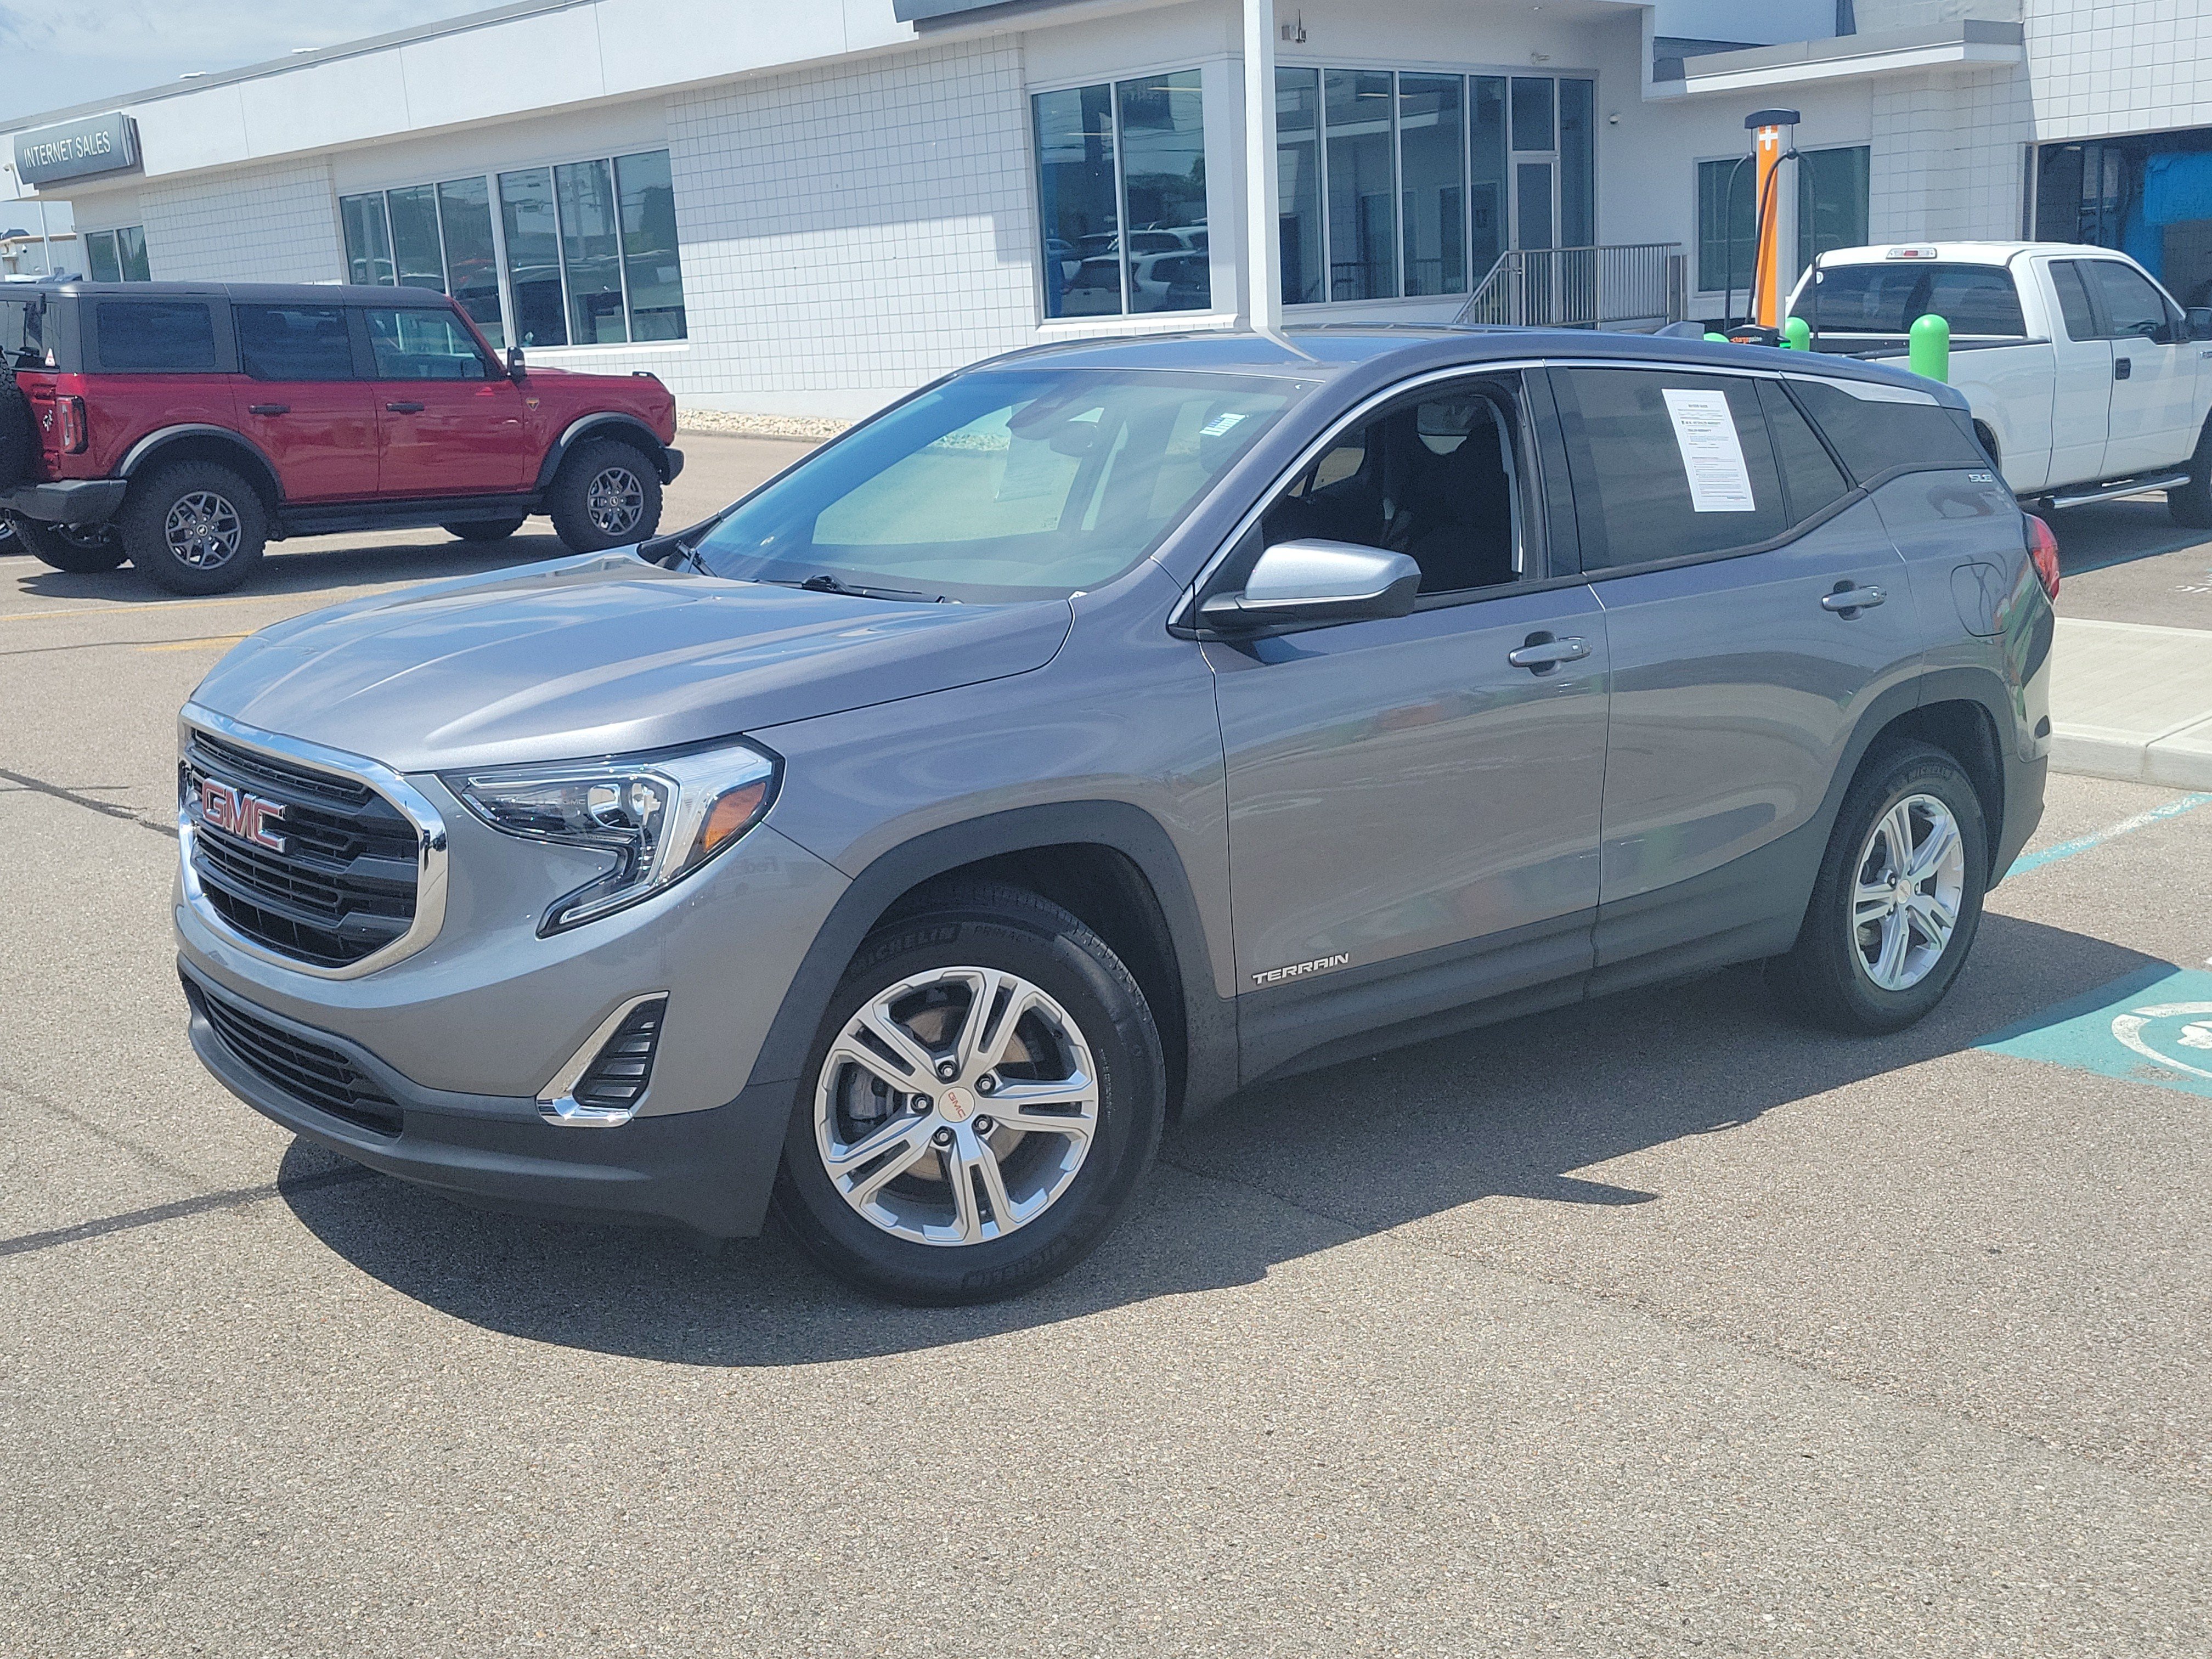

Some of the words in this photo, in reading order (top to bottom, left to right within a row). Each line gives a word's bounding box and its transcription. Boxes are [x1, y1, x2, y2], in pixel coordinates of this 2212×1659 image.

[24, 139, 73, 168] INTERNET
[75, 131, 111, 158] SALES
[202, 778, 287, 854] GMC
[1251, 951, 1349, 985] TERRAIN
[948, 1092, 966, 1119] GMC
